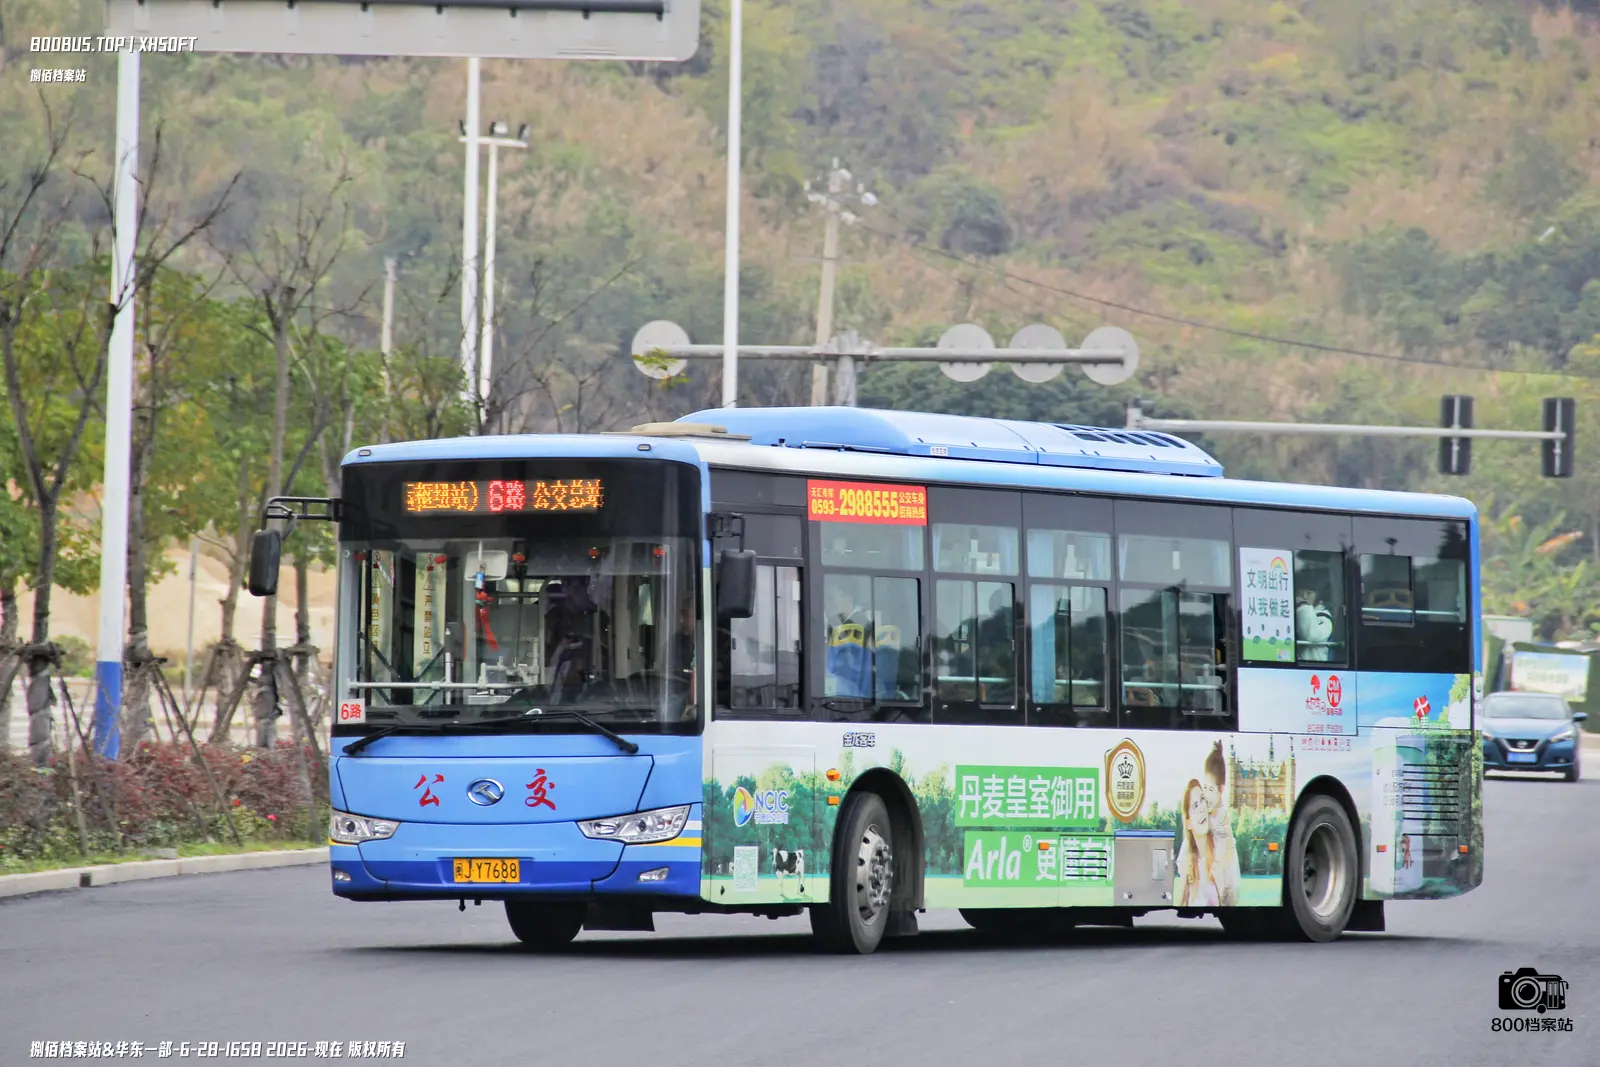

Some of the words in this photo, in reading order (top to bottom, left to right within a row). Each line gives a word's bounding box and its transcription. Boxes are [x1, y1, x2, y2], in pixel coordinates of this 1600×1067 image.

[487, 480, 525, 512] 6路
[899, 491, 924, 504] 公交车身
[1246, 569, 1289, 591] 文明出行
[1247, 597, 1290, 618] 从我做起
[341, 703, 362, 720] 6路
[842, 731, 876, 748] 金龙客车
[755, 791, 788, 811] NCIC
[958, 774, 1096, 820] 丹麦皇室御用
